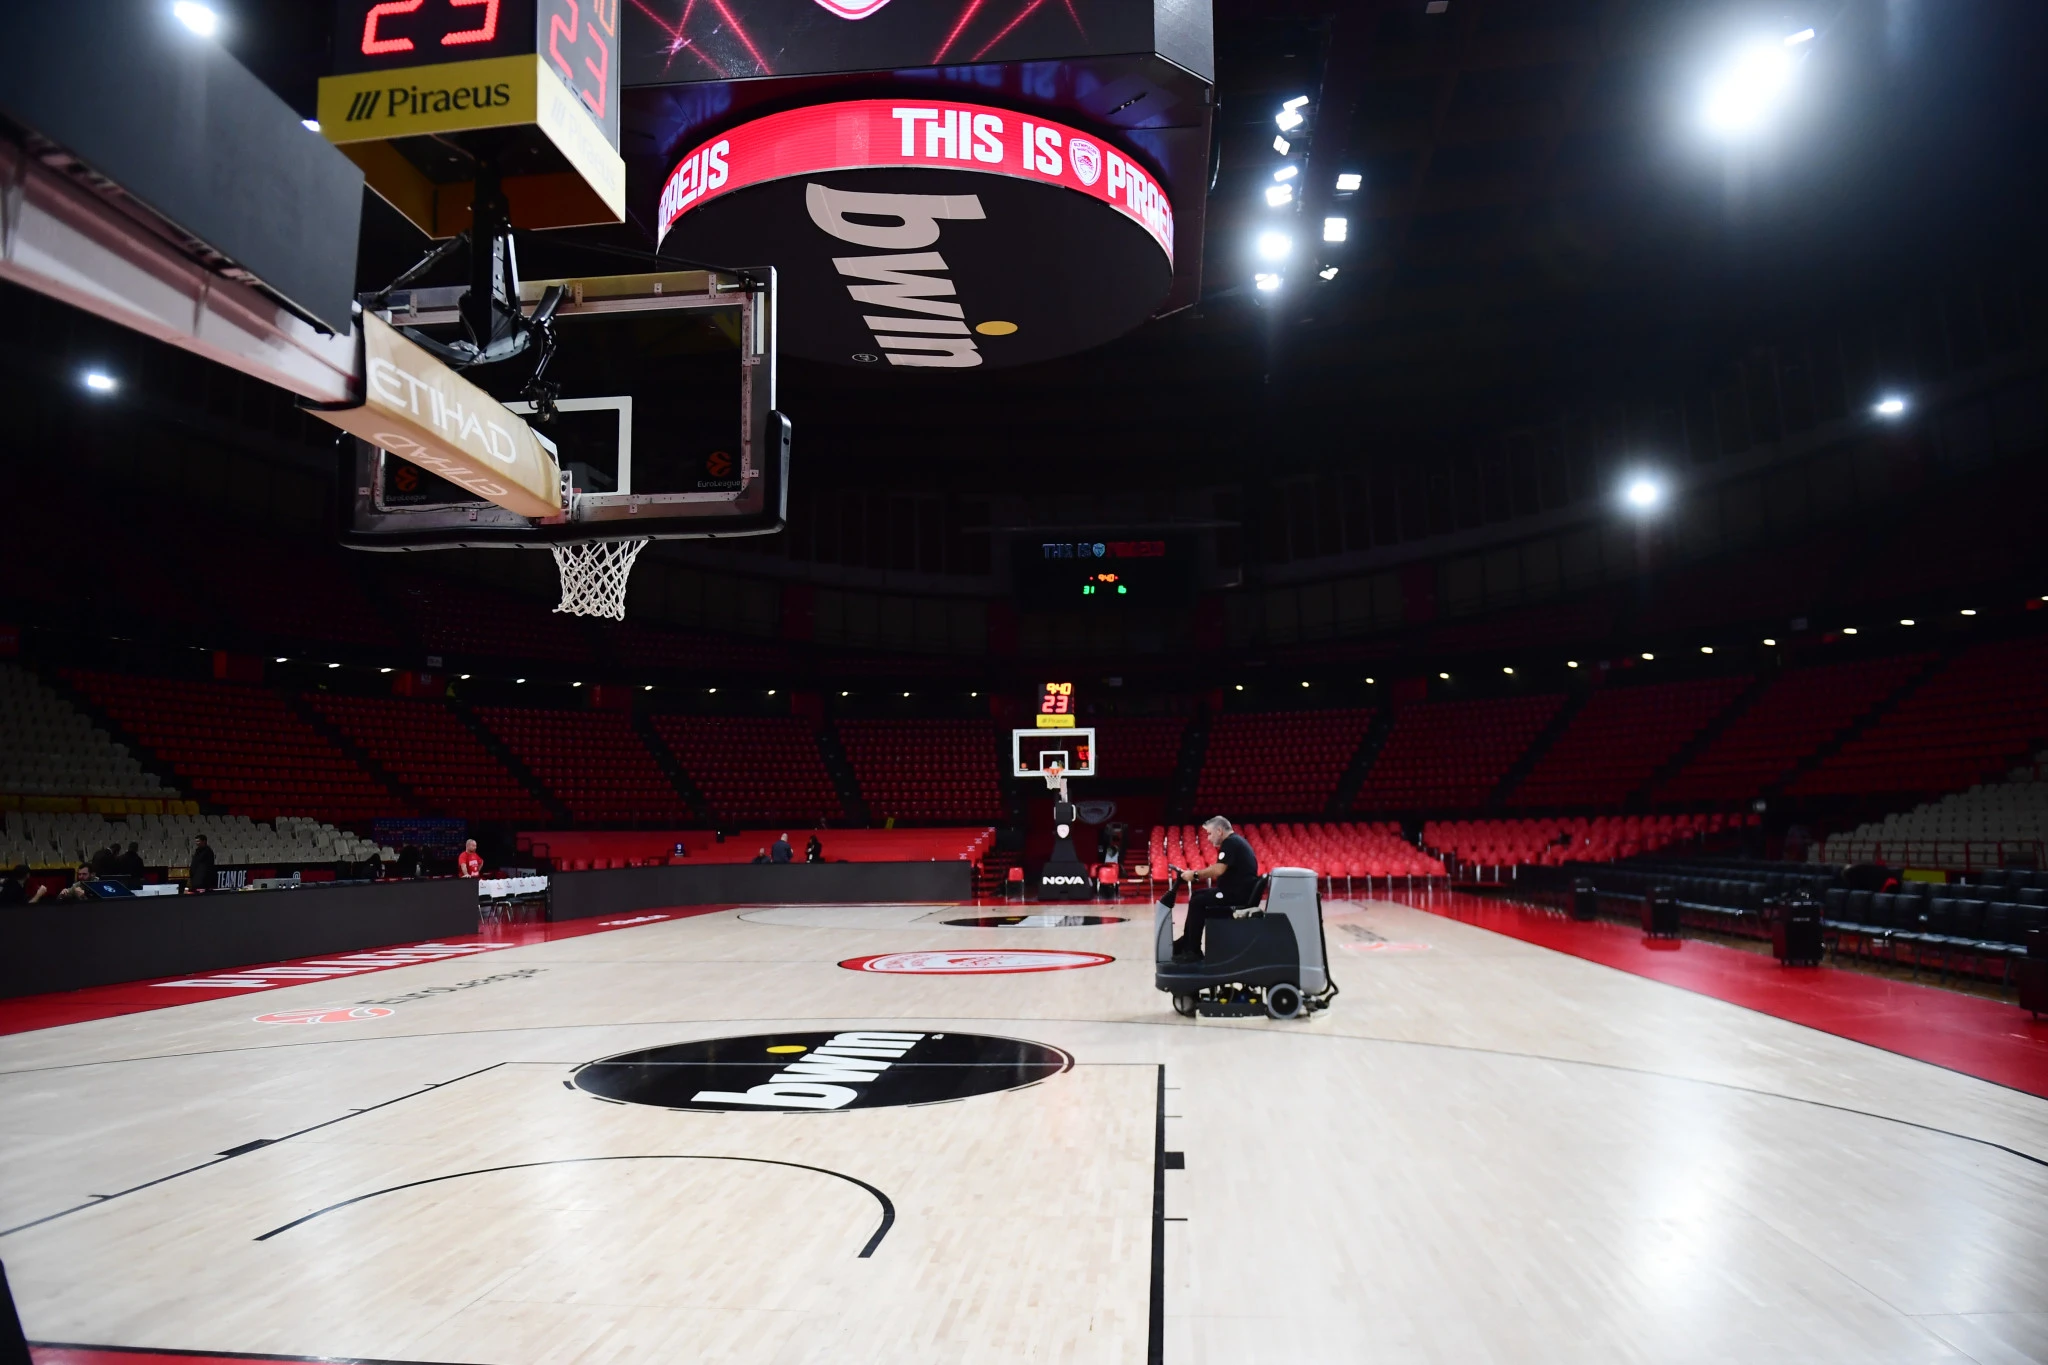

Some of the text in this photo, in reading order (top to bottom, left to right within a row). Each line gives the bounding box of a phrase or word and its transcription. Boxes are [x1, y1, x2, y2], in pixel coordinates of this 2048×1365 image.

[387, 83, 510, 118] Piraeus
[892, 107, 1004, 164] THIS
[1022, 121, 1063, 176] IS
[806, 182, 1019, 368] bwin
[369, 356, 517, 464] ETIHAD
[373, 432, 508, 496] ETIHAD
[697, 480, 741, 489] EuroLeague
[1042, 695, 1069, 713] 23
[217, 870, 237, 889] TEAM
[1042, 876, 1085, 885] NOVA
[690, 1031, 926, 1110] bwin
